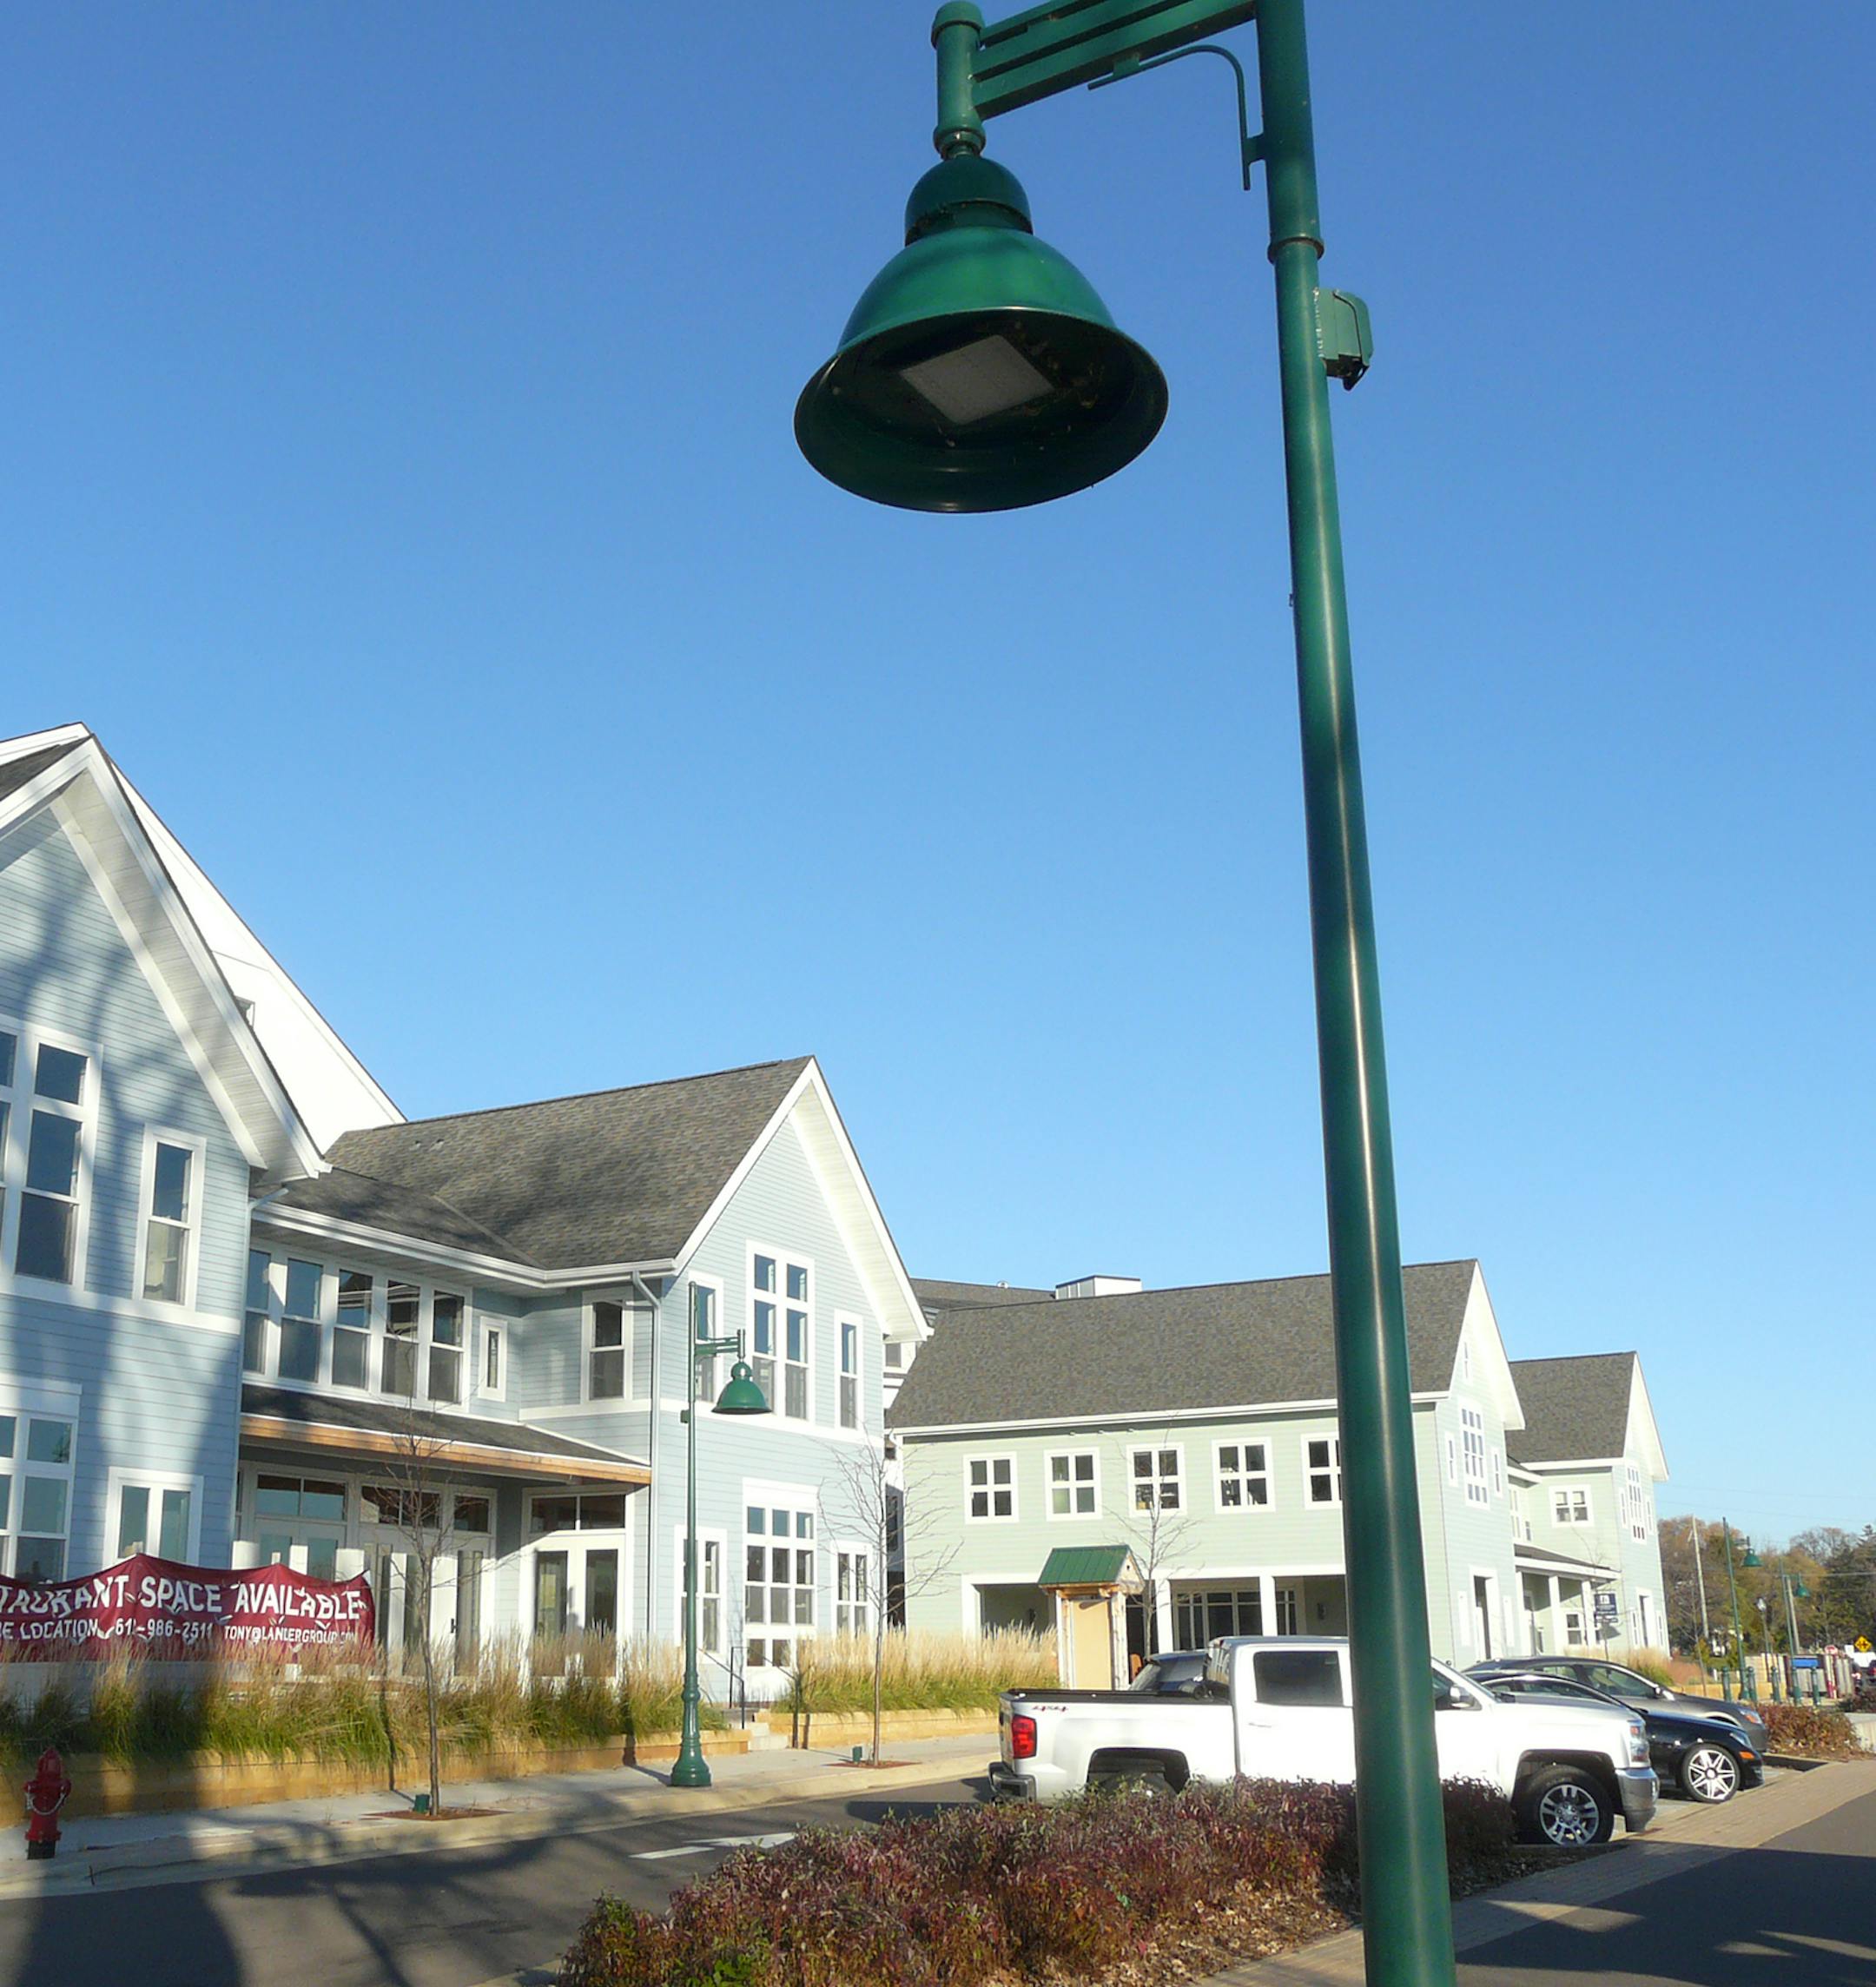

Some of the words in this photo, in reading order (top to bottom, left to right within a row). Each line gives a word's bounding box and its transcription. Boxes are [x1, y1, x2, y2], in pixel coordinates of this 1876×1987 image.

[140, 1576, 222, 1613] SPACE
[234, 1583, 361, 1620] AVAILABLE
[20, 1618, 98, 1640] LOCATION
